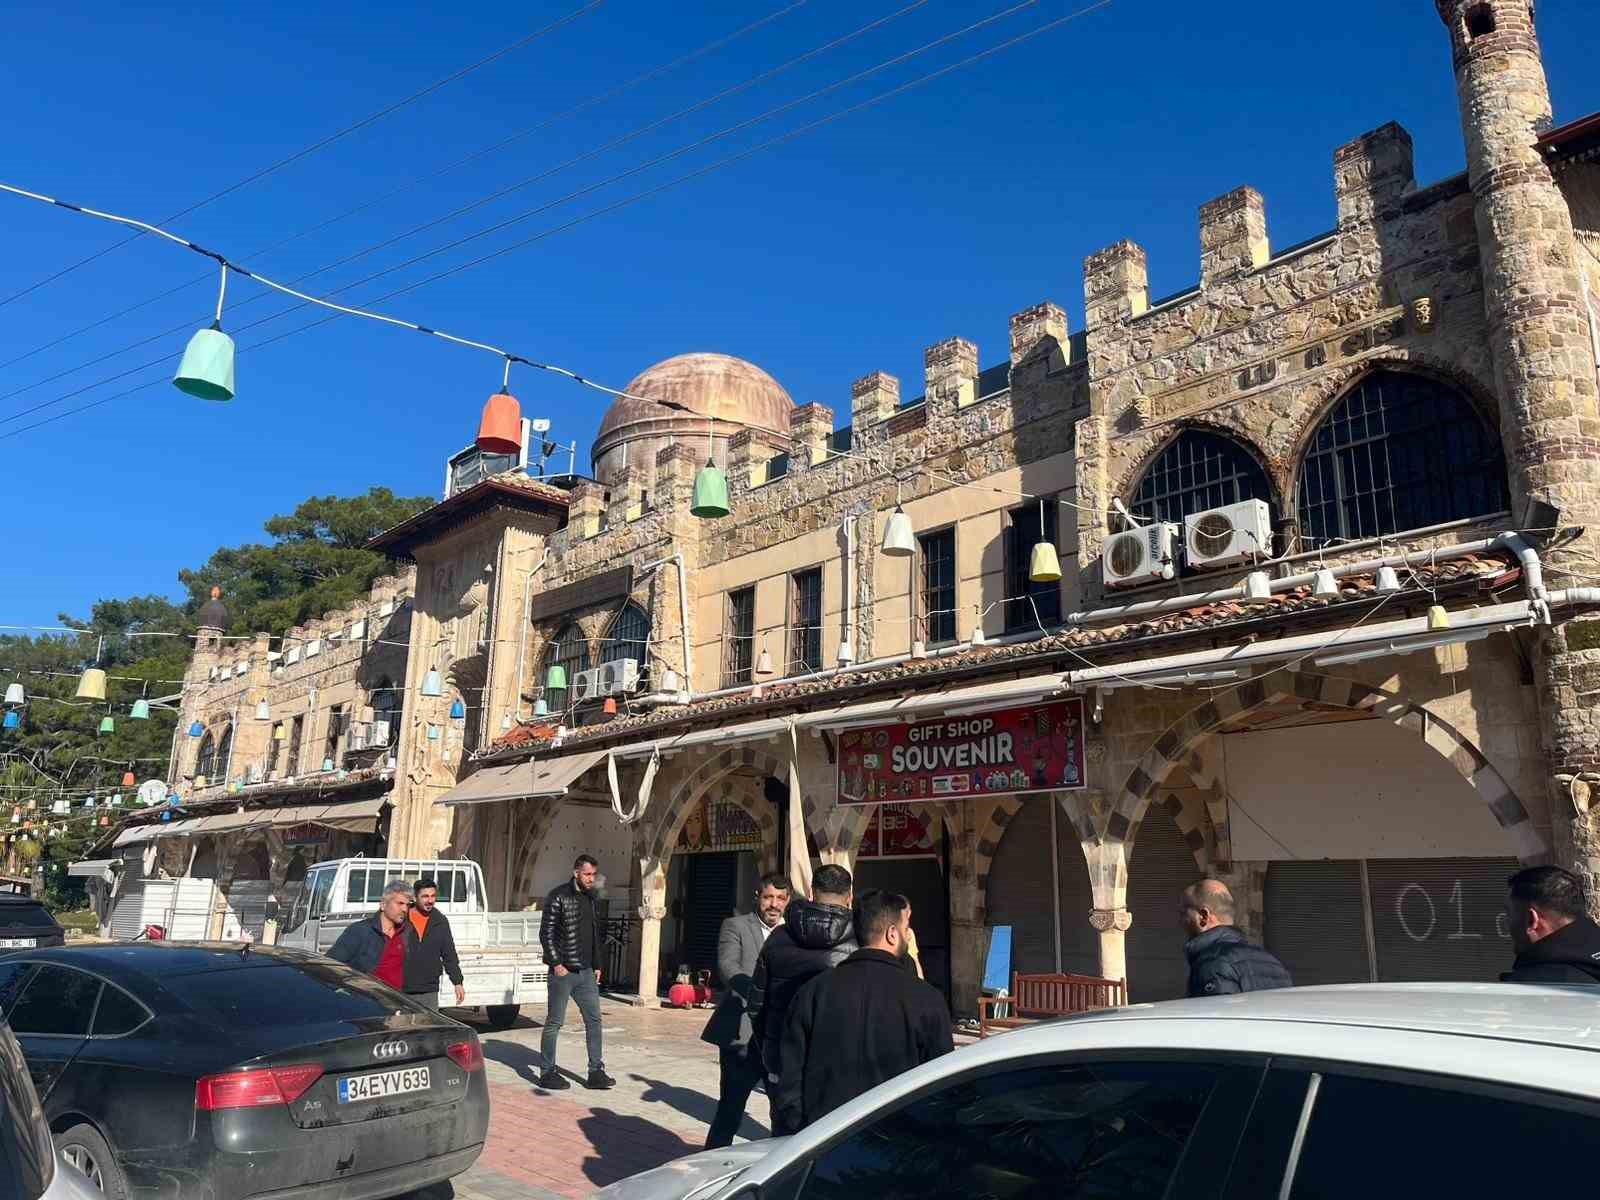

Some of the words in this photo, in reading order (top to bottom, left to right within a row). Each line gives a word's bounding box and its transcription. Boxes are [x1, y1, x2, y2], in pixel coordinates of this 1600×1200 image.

[909, 725, 944, 742] GIFT
[947, 718, 993, 737] SHOP
[893, 732, 1014, 772] SOUVENIR
